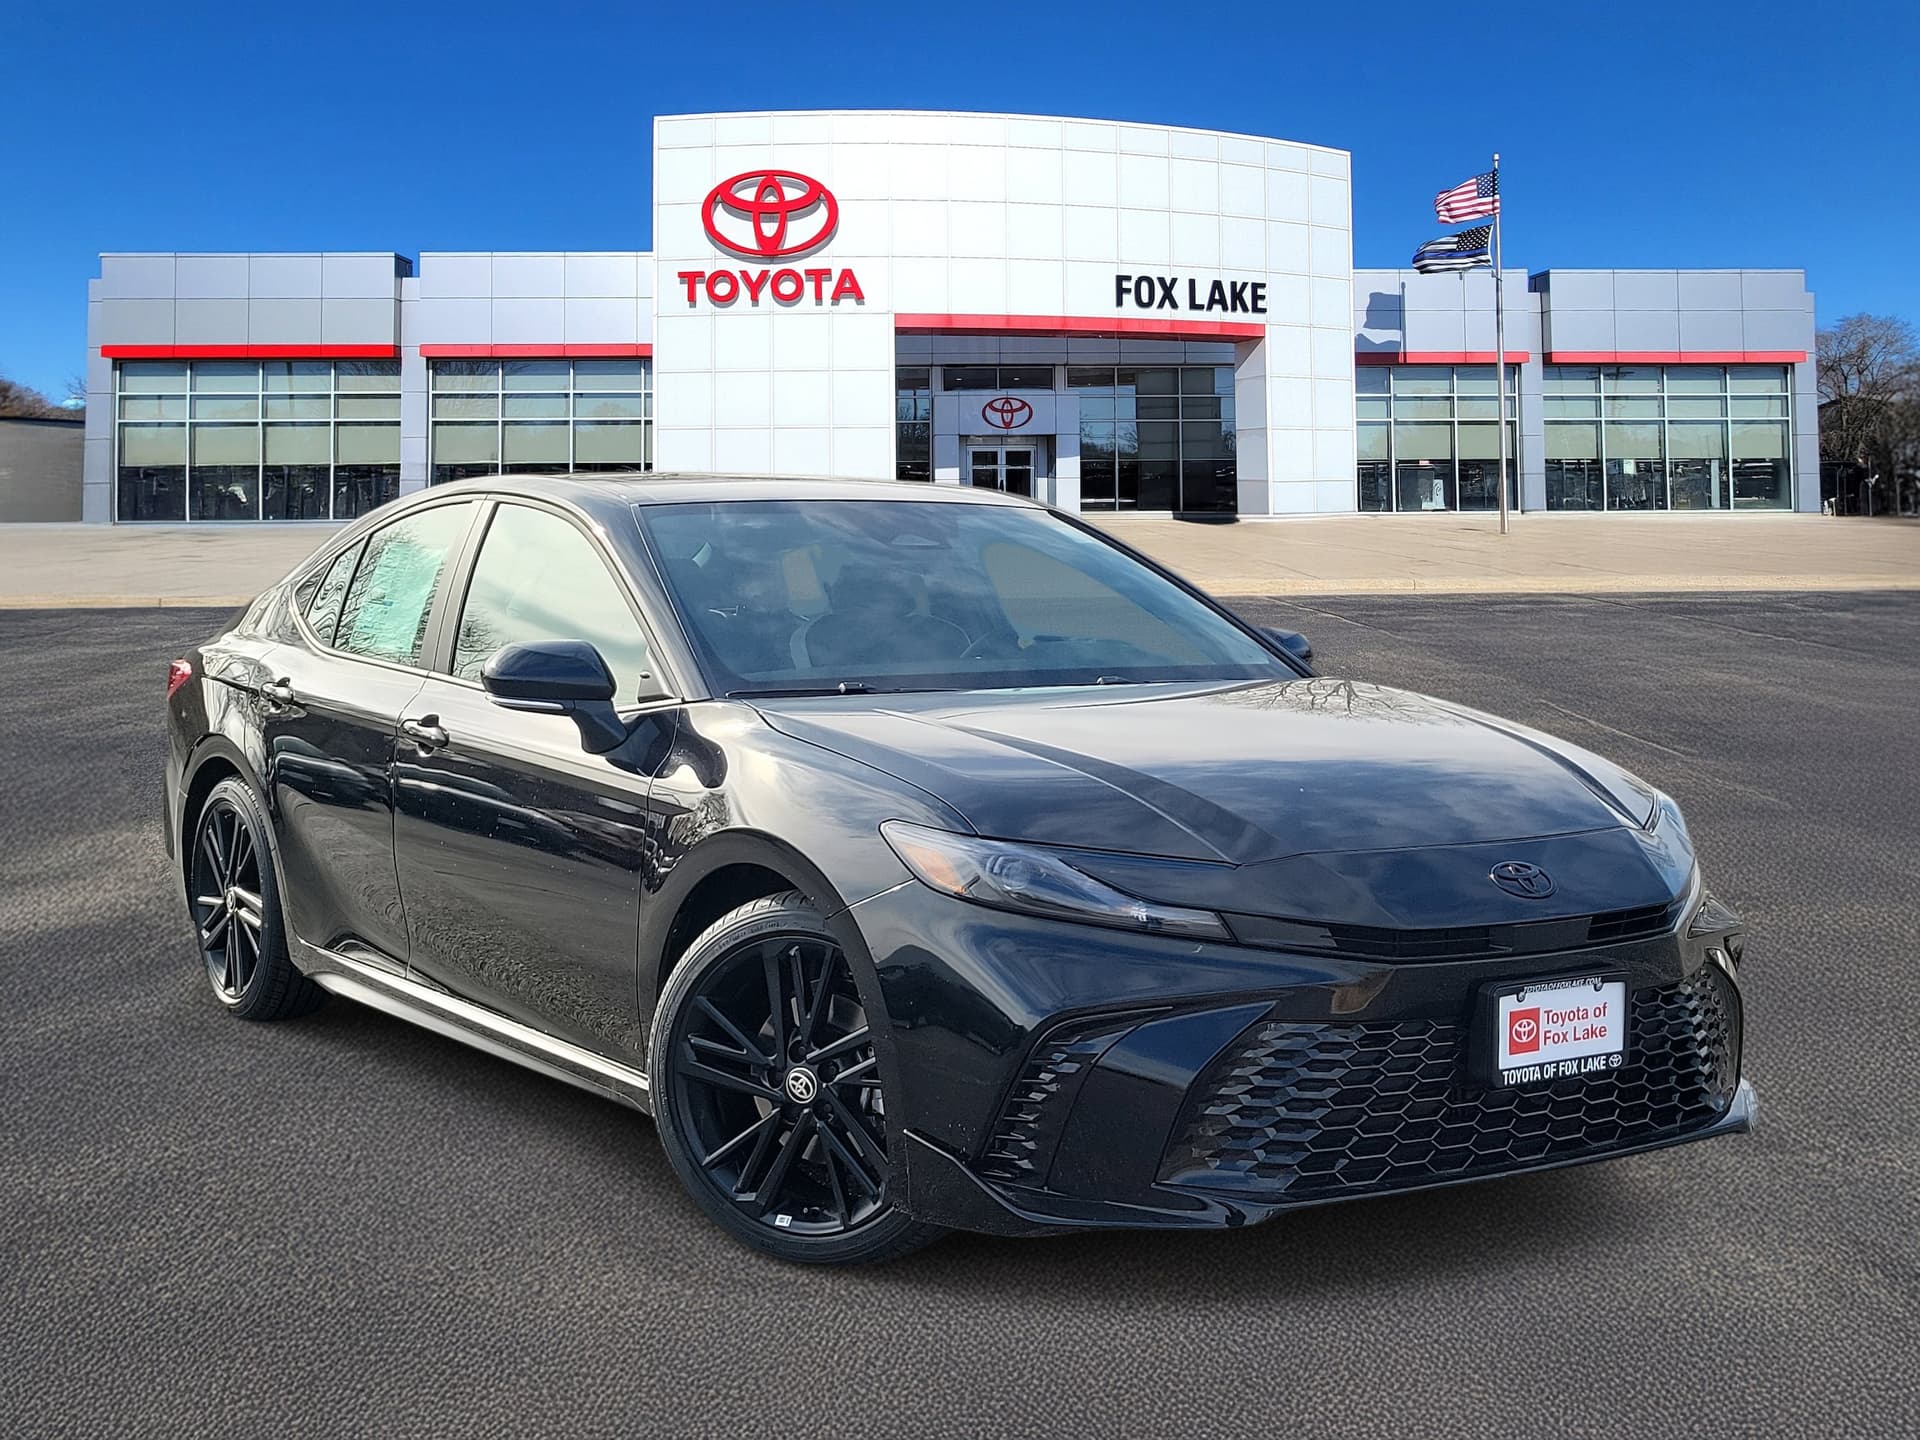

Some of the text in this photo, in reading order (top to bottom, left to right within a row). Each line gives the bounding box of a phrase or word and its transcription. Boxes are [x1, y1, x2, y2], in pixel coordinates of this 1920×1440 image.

[678, 268, 865, 307] TOYOTA
[1115, 275, 1267, 313] FOX LAKE
[1544, 1002, 1607, 1027] Toyota of
[1544, 1024, 1607, 1046] Fox Lake
[1503, 1056, 1606, 1085] TOYOTA OF FOX LAKE
